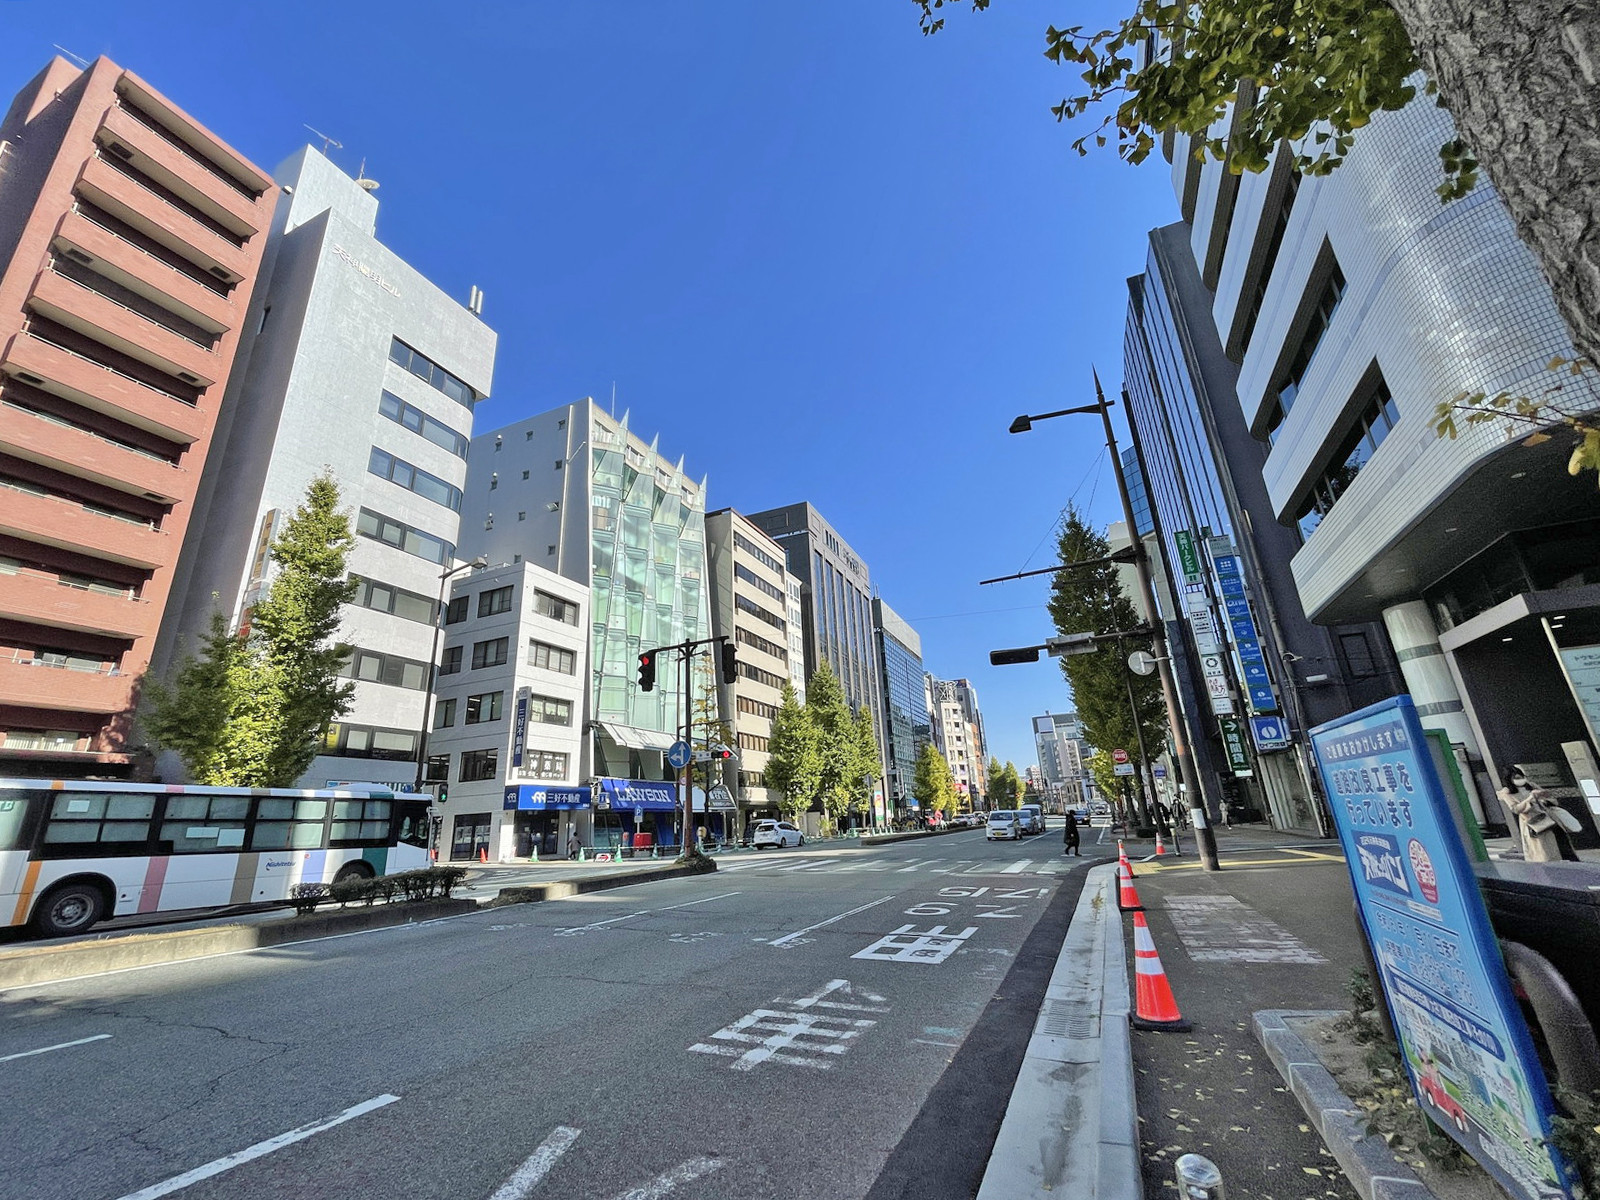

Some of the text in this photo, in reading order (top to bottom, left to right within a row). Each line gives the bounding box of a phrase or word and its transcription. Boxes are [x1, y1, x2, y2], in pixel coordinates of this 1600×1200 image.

[514, 708, 525, 754] 三好不動産
[1332, 763, 1413, 794] 道路改良工事を
[547, 793, 581, 803] 三好不動産
[615, 787, 671, 802] LAWSON
[1346, 798, 1412, 828] 行っています
